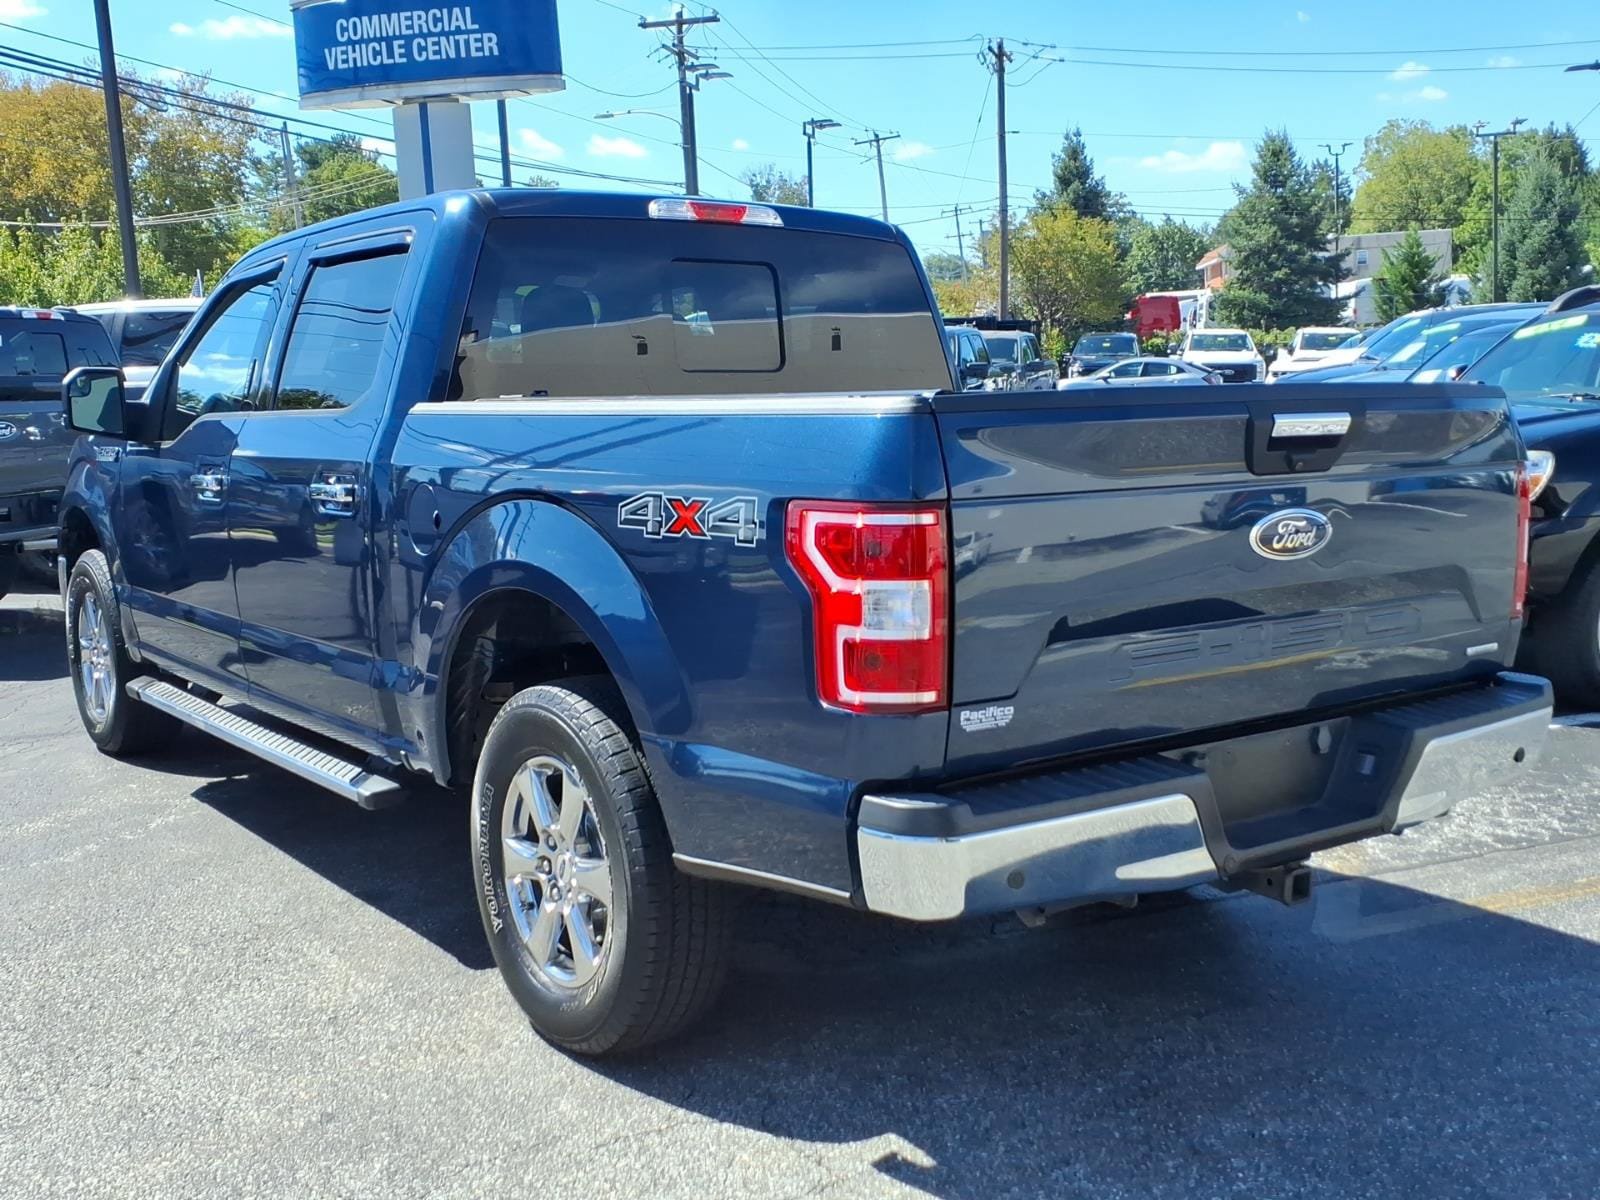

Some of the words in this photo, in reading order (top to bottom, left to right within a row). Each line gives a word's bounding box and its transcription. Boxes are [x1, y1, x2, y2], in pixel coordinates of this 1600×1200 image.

[335, 6, 479, 43] COMMERCIAL
[324, 39, 407, 71] VEHICLE
[412, 32, 499, 62] CENTER
[1272, 520, 1317, 550] Ford
[960, 706, 1014, 723] Pacifico
[479, 782, 504, 935] YOKOHAMA
